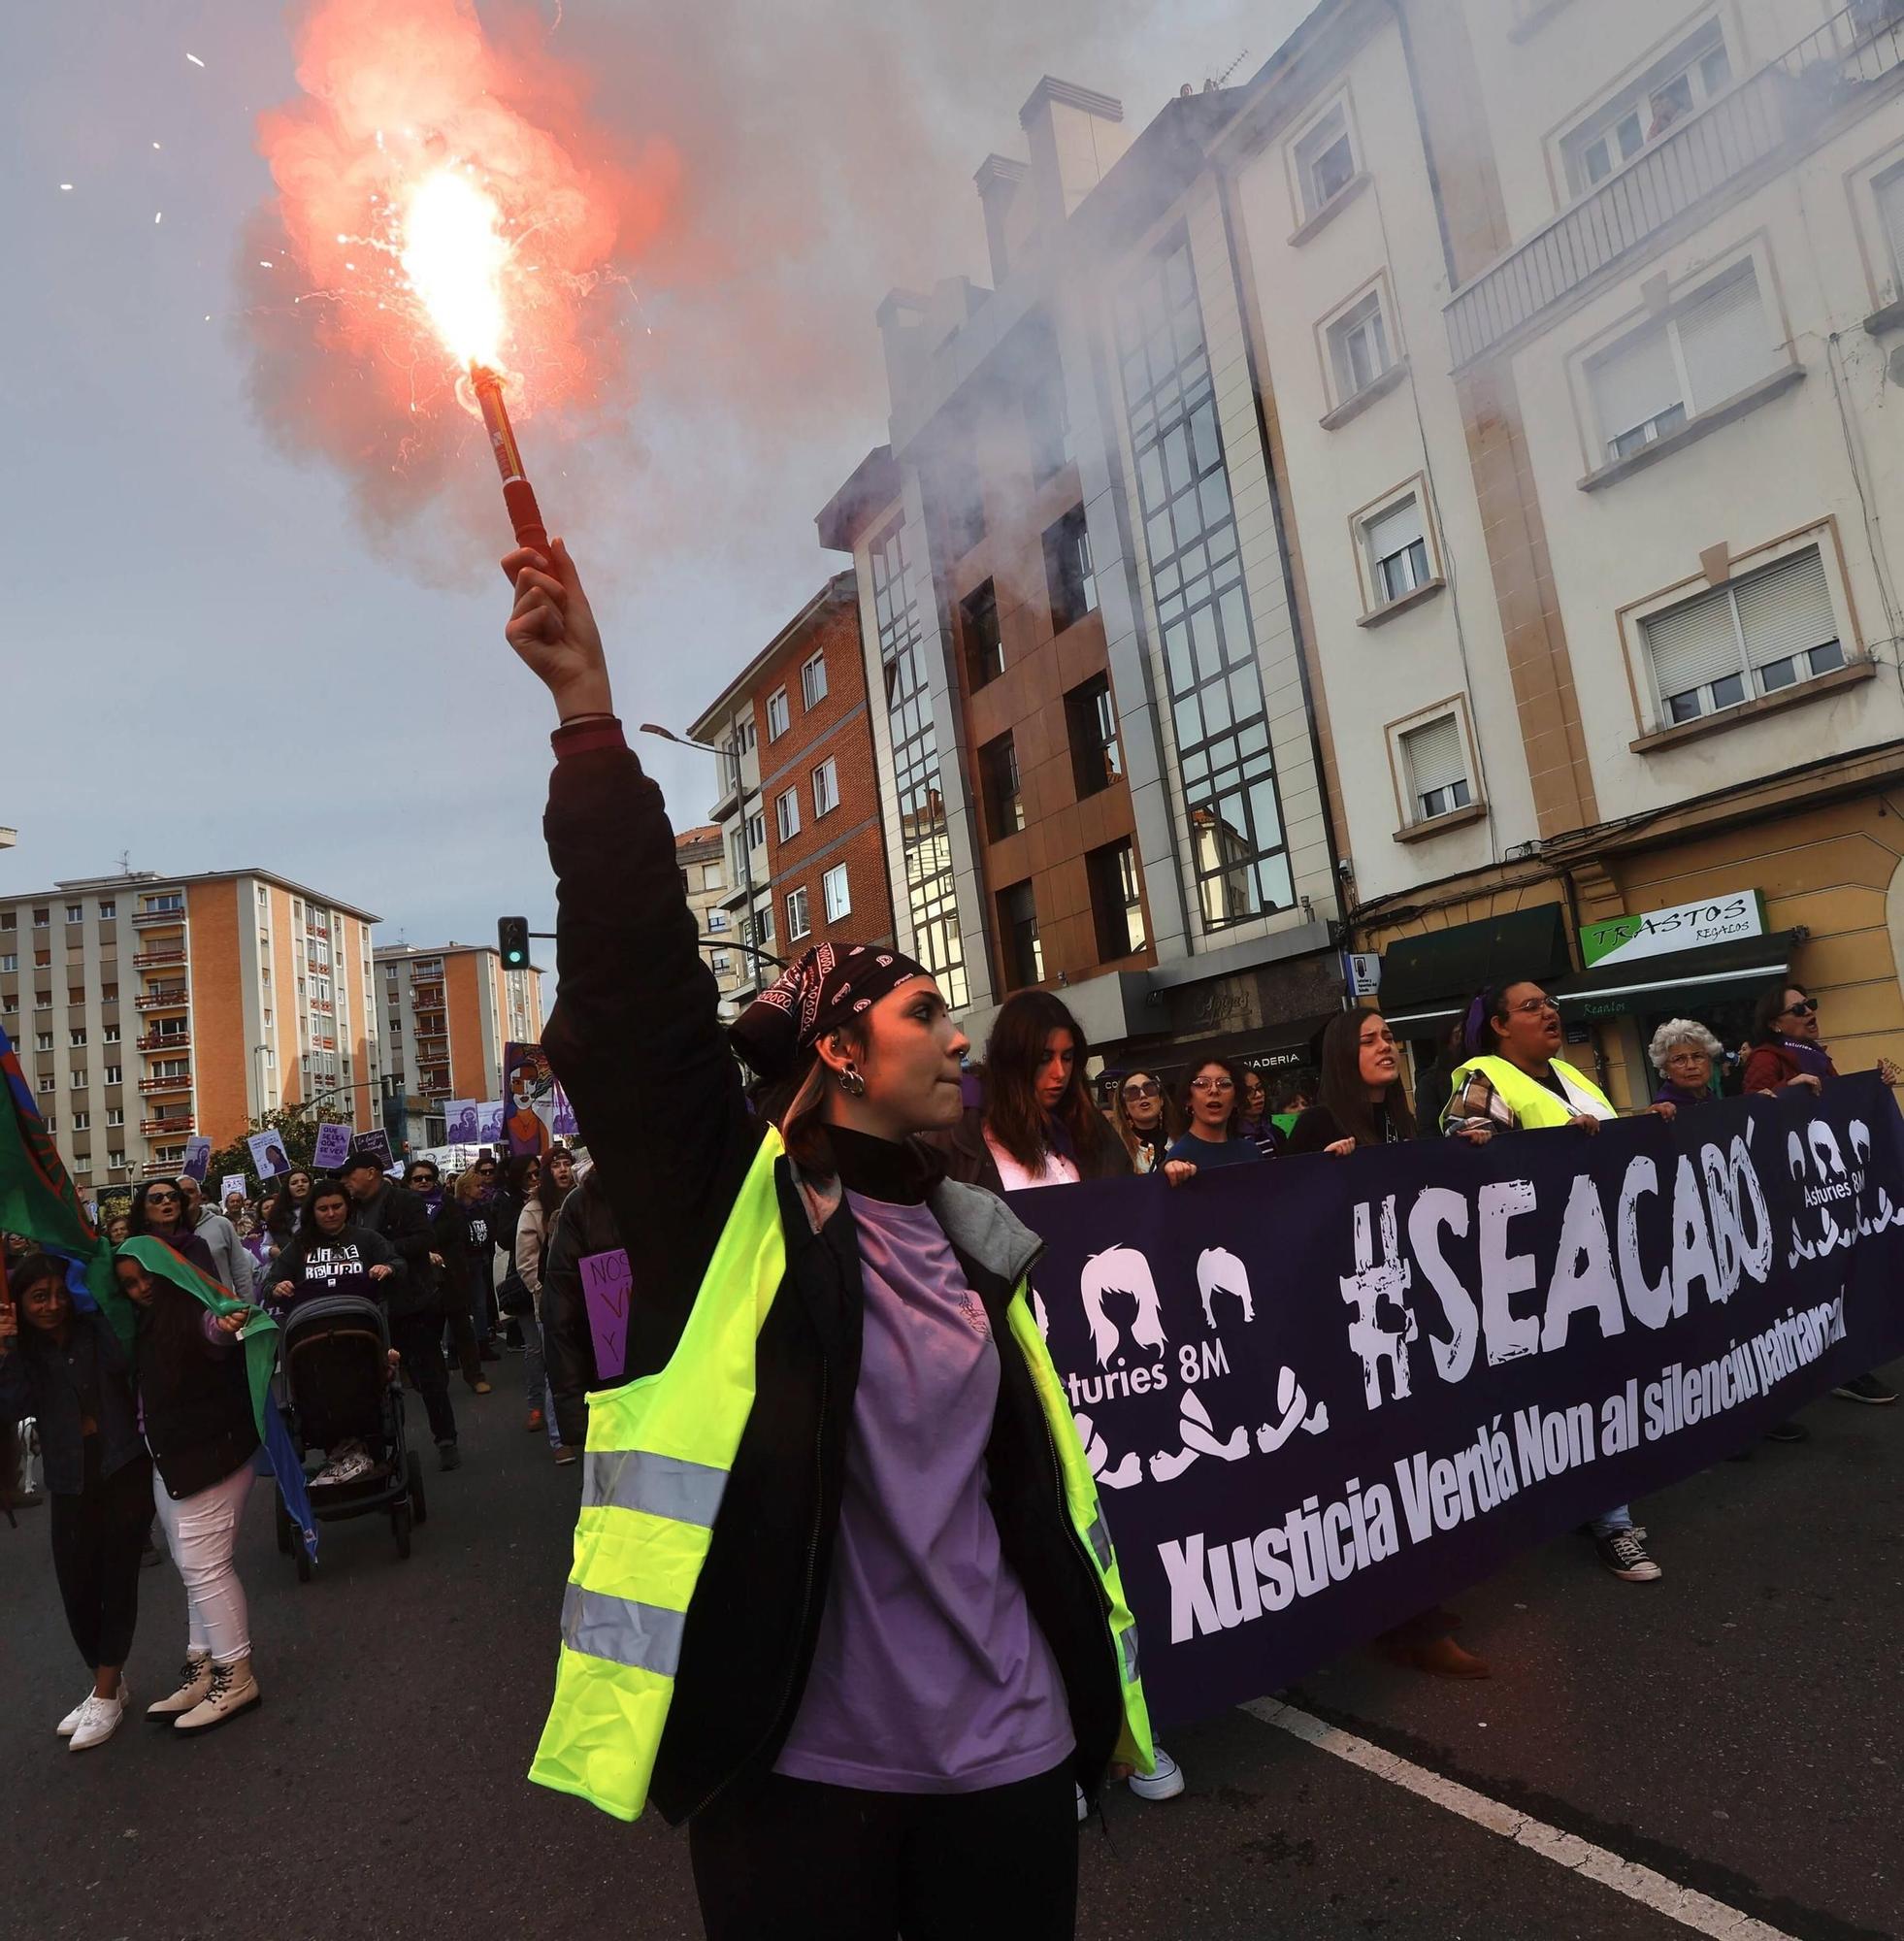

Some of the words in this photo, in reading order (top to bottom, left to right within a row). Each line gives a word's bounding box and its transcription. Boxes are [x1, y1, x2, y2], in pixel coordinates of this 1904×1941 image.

[1592, 899, 1747, 947] TRASTOS
[1695, 921, 1750, 941] REGALOS
[332, 1134, 346, 1143] LEA
[1804, 1178, 1853, 1208] Asturies
[1851, 1169, 1866, 1195] 8M
[1339, 1115, 1773, 1410] #SEACABÓ
[1067, 1357, 1168, 1407] turies
[1178, 1337, 1231, 1384] 8M
[1157, 1476, 1400, 1645] Xusticia
[1394, 1413, 1519, 1545] Verdá
[1513, 1402, 1596, 1489] Non
[1600, 1378, 1639, 1457] al
[1644, 1338, 1759, 1442] silenciu
